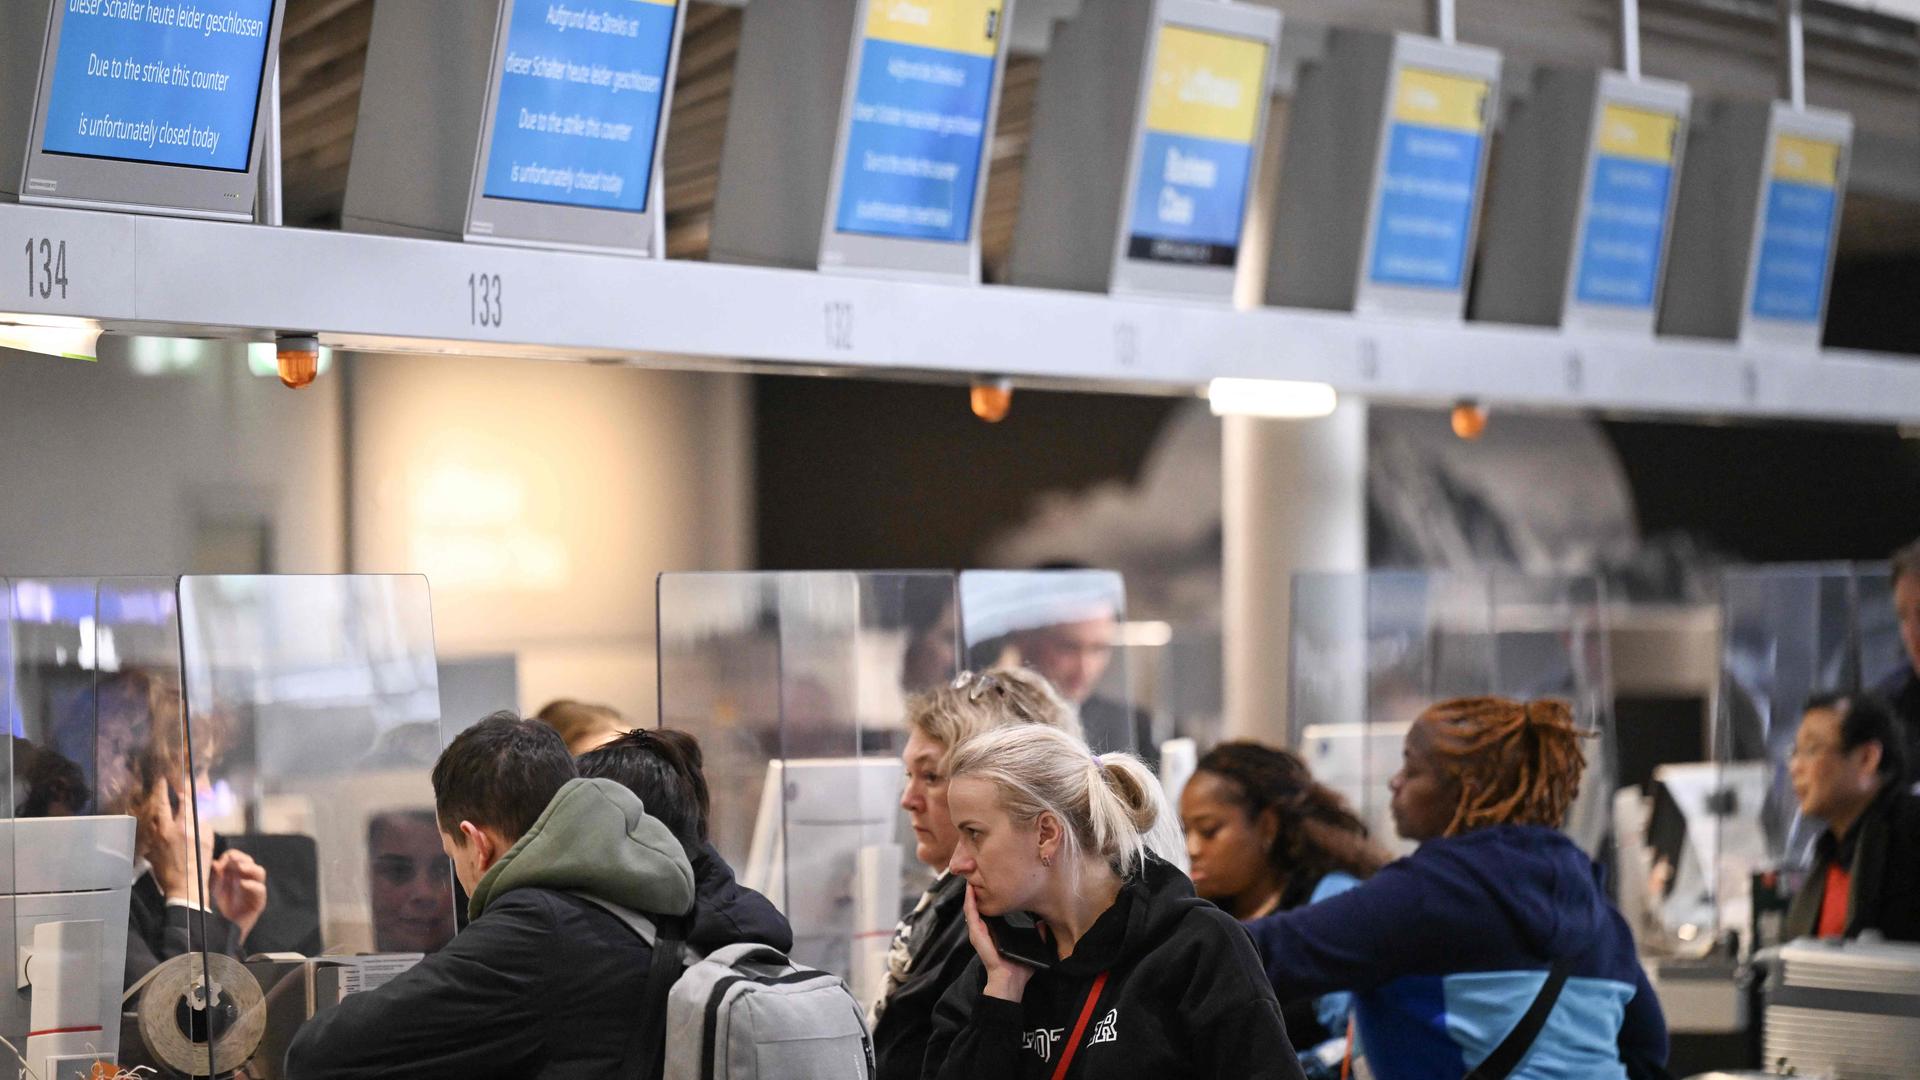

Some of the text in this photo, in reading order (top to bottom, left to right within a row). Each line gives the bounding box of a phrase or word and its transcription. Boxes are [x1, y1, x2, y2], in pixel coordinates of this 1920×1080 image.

[69, 0, 264, 37] dieser Schalter heute leider geschlossen
[88, 53, 230, 92] Due to the strike this counter
[78, 112, 220, 155] is unfortunately closed today
[519, 107, 537, 130] Due
[25, 238, 68, 299] 134
[469, 273, 502, 328] 133
